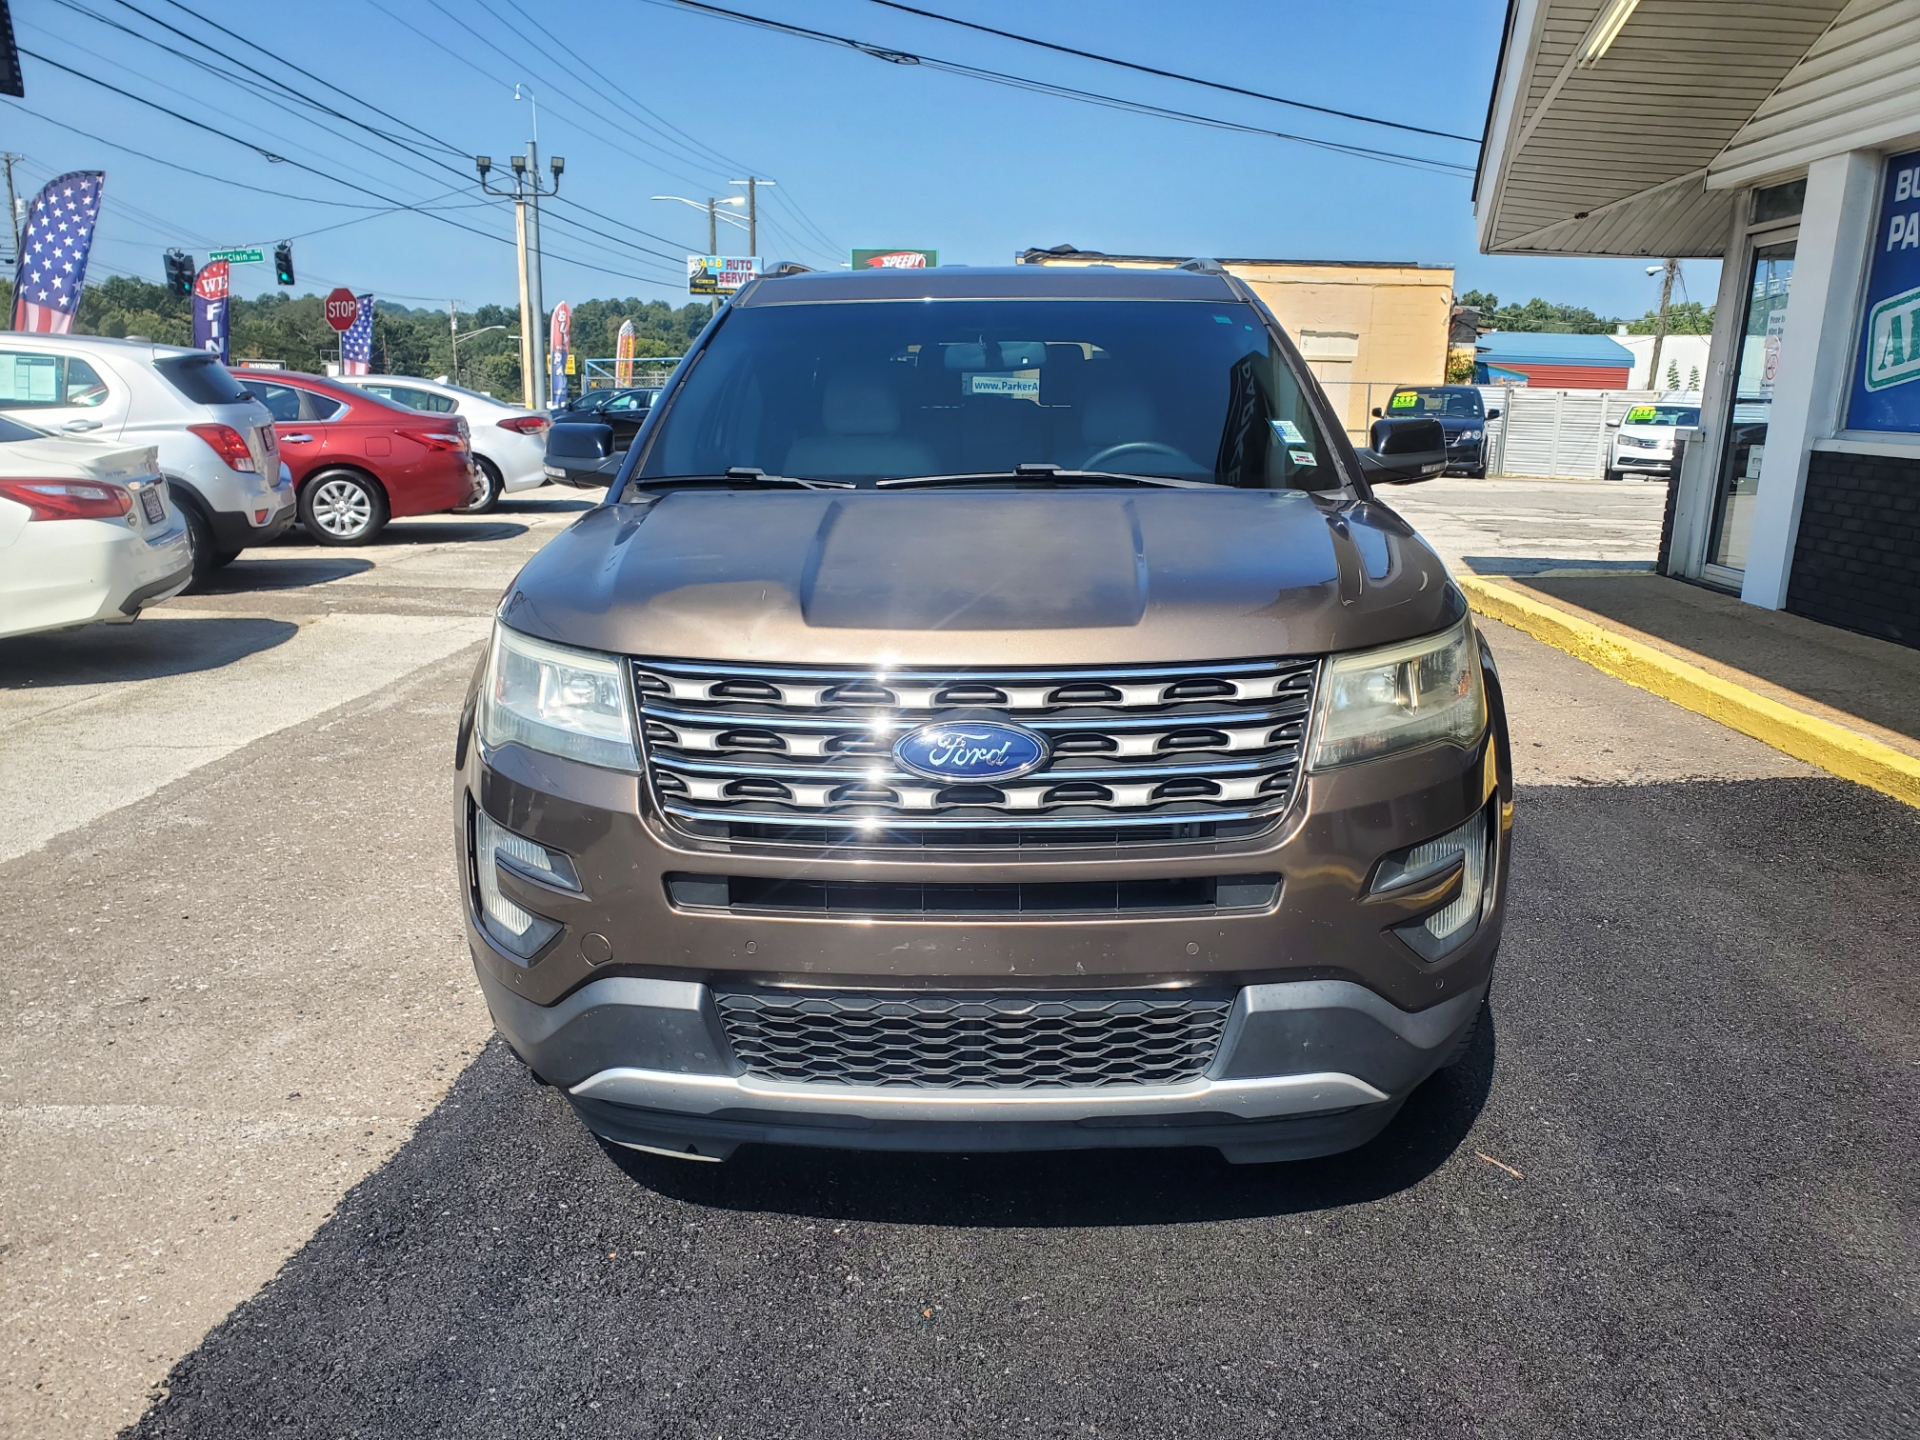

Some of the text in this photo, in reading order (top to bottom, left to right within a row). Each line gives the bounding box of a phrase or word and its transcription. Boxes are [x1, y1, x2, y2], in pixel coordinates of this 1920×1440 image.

[701, 258, 707, 268] A
[716, 258, 722, 268] B
[726, 260, 752, 270] AUTO
[881, 254, 924, 268] SPEEDY
[202, 275, 228, 293] WE
[329, 301, 355, 318] STOP
[975, 381, 1038, 391] www.ParkerA
[929, 732, 1012, 766] Ford
